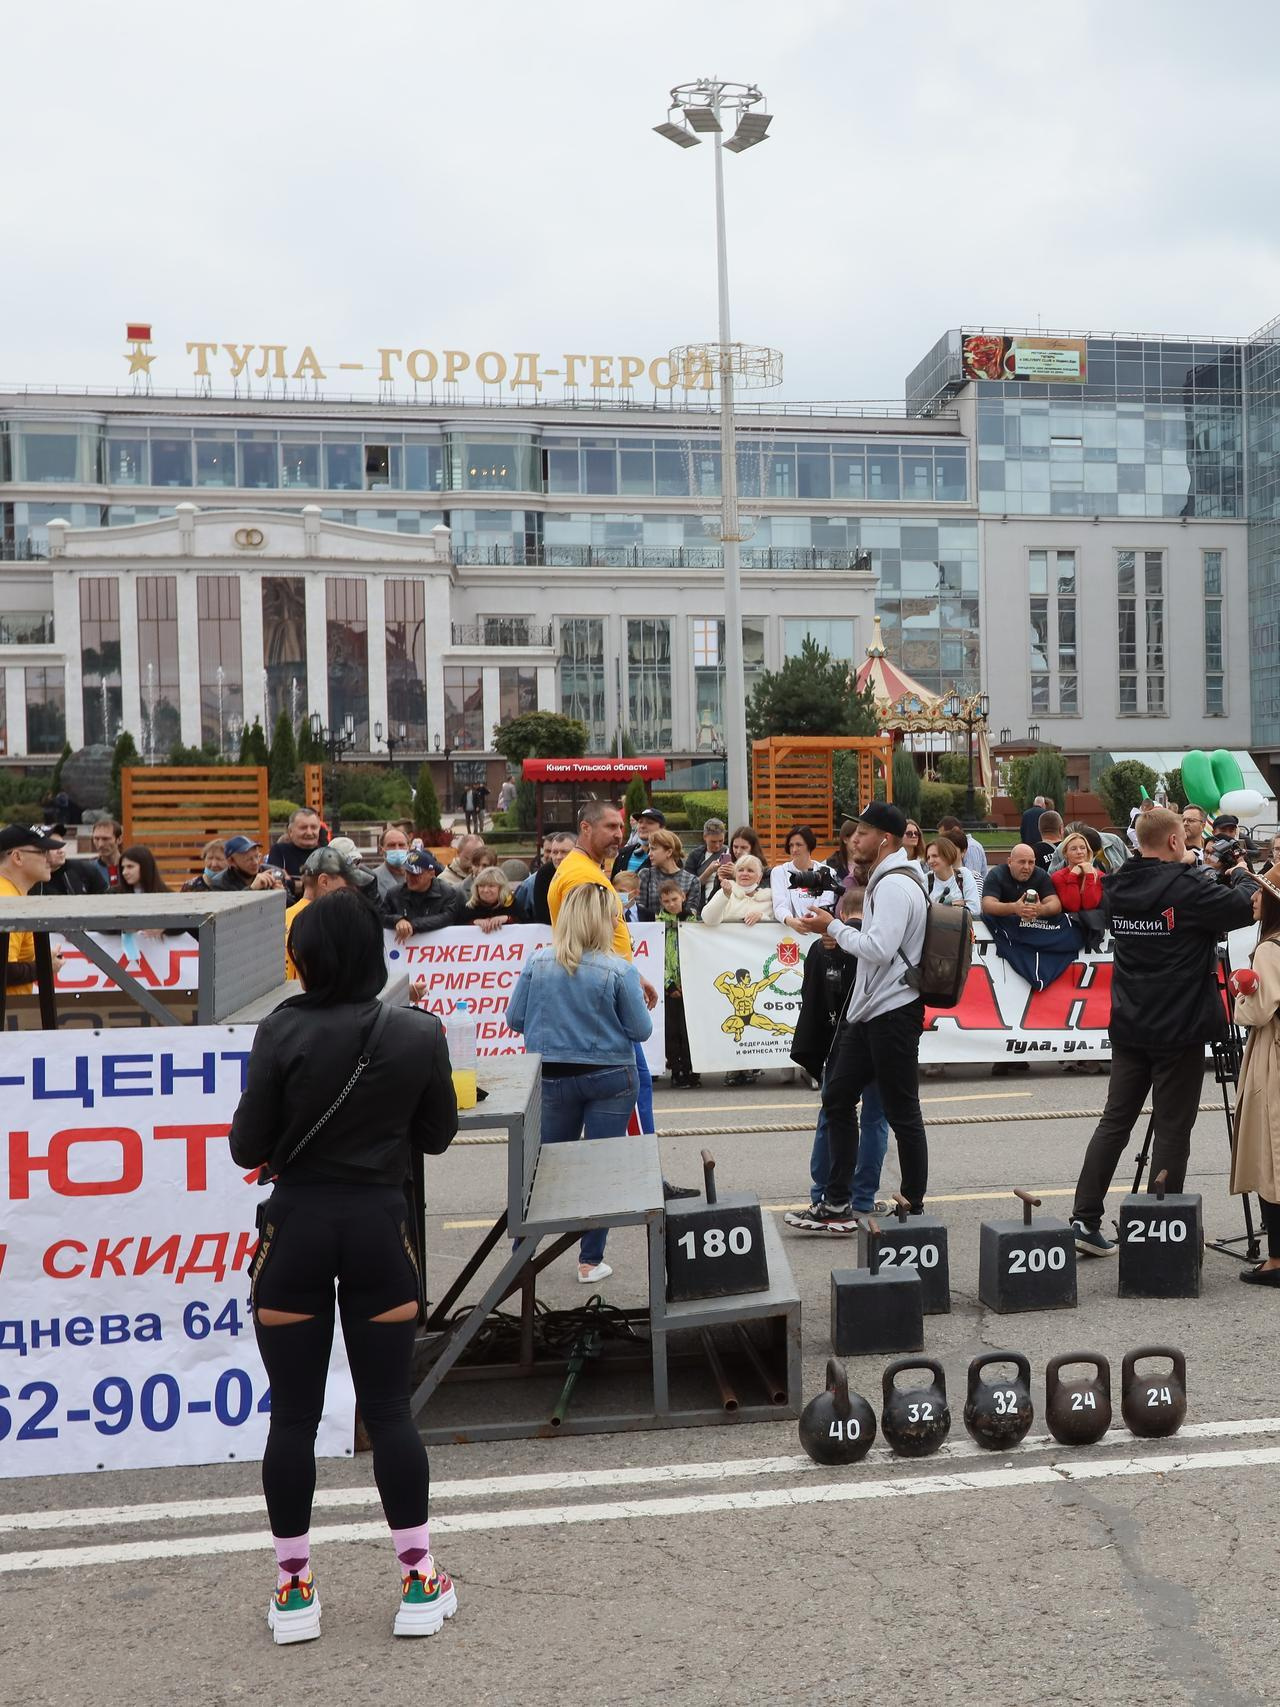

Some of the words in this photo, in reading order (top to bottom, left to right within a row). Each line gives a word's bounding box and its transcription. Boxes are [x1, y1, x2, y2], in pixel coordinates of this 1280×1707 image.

[185, 342, 327, 379] ТУЛА
[378, 348, 714, 392] ГОРОД-ГЕРОЙ
[573, 763, 612, 772] Тульской
[614, 763, 648, 771] области
[1112, 919, 1163, 931] ТУЛЬСКИЙ
[405, 943, 524, 963] ТЯЖЕЛАЯ
[1006, 1039, 1058, 1054] Тула,
[1064, 1040, 1094, 1053] ул.
[677, 1226, 753, 1261] 180
[1127, 1219, 1188, 1245] 240
[878, 1244, 940, 1270] 220
[1007, 1246, 1067, 1275] 200
[992, 1390, 1019, 1415] 32
[1070, 1391, 1097, 1413] 24
[1146, 1386, 1173, 1408] 24
[907, 1402, 935, 1424] 32
[828, 1418, 861, 1442] 40
